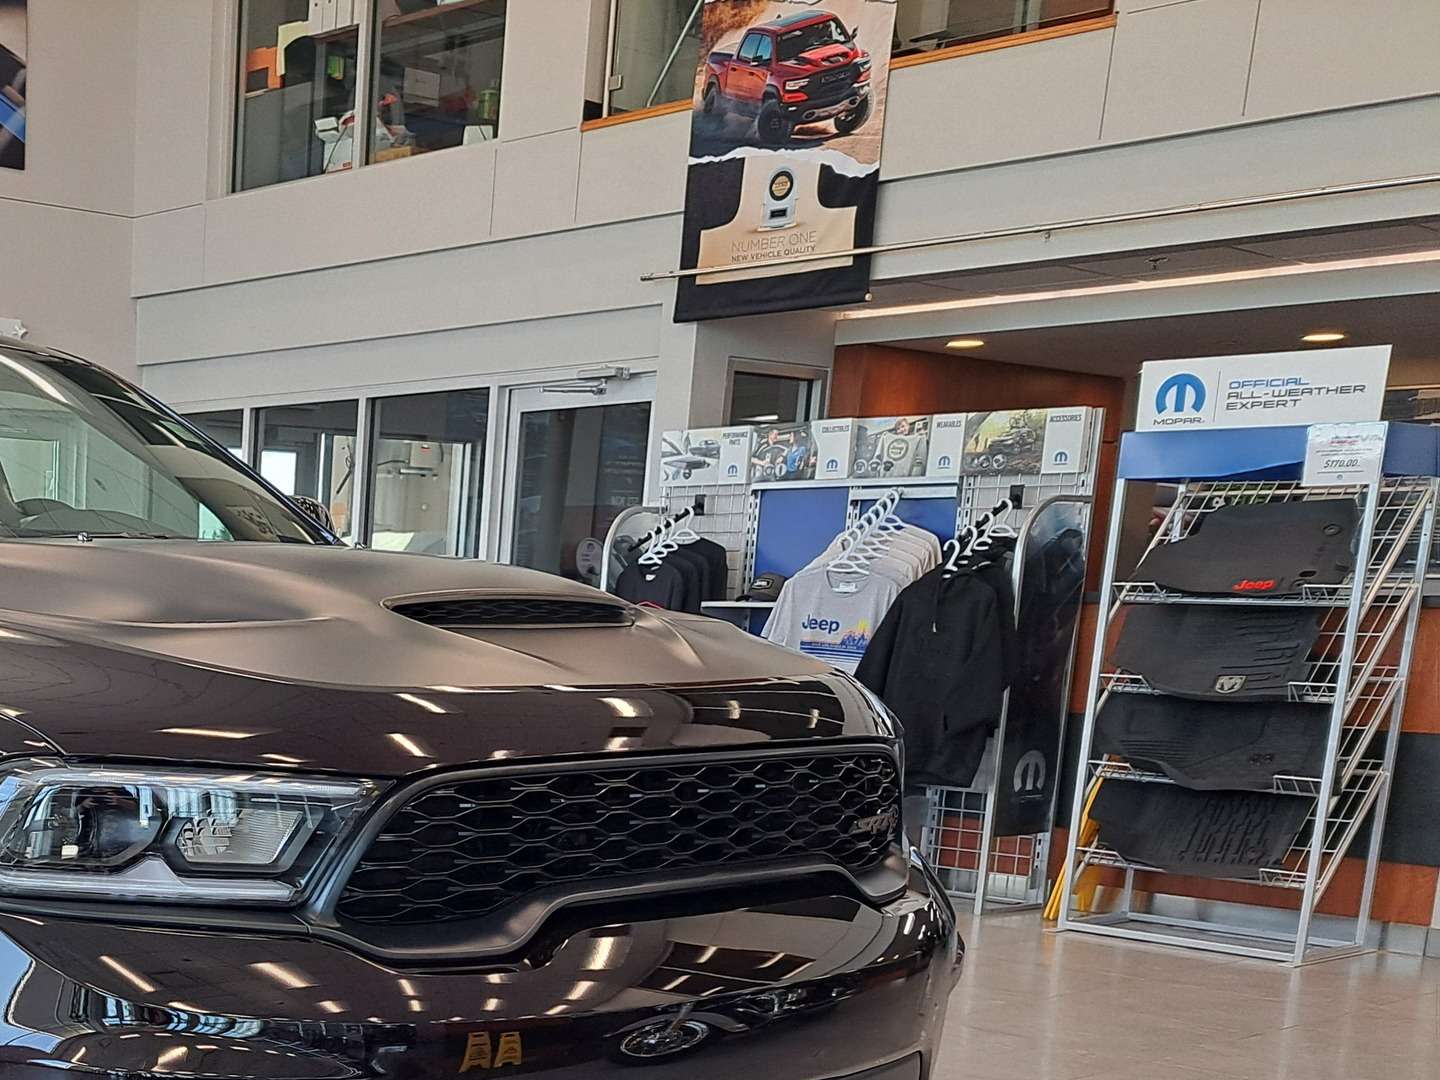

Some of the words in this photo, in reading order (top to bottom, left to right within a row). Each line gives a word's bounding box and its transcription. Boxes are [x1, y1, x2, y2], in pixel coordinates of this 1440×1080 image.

[731, 235, 785, 252] NUMBER
[789, 231, 817, 245] ONE
[731, 254, 749, 262] NEW
[750, 250, 782, 260] VEHICLE
[784, 245, 816, 256] QUALITY
[1228, 377, 1310, 390] OFFICIAL
[1226, 384, 1367, 400] ALL-WEATHER
[1225, 399, 1302, 411] EXPERT
[1153, 417, 1202, 426] MOPAR
[1231, 579, 1276, 592] Jeep
[802, 614, 840, 634] Jeep
